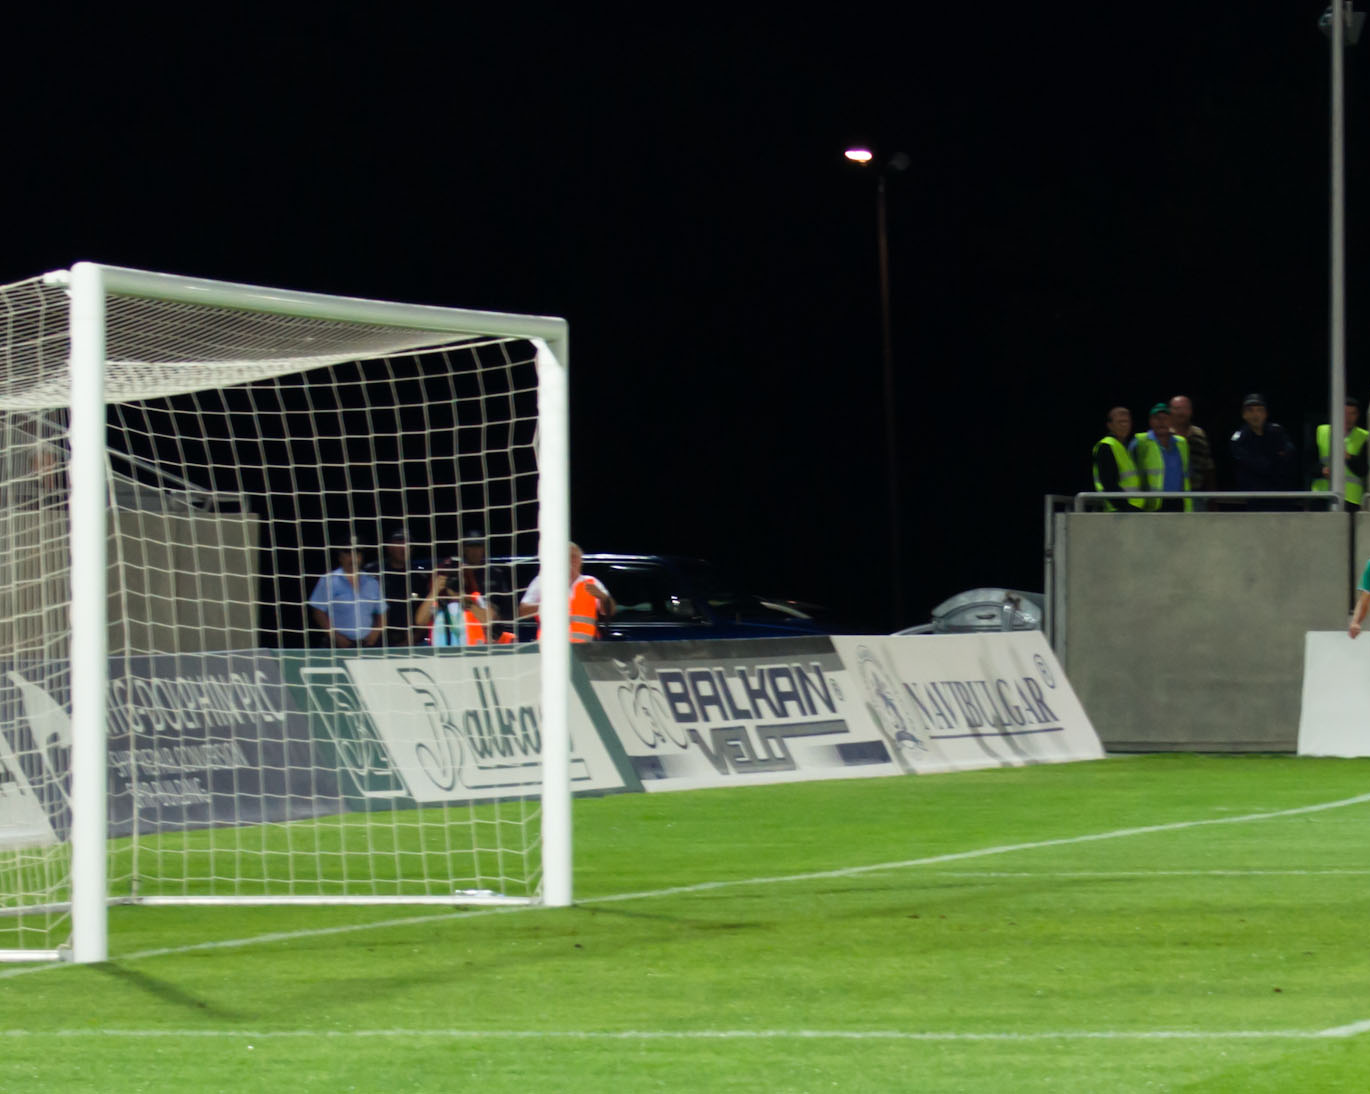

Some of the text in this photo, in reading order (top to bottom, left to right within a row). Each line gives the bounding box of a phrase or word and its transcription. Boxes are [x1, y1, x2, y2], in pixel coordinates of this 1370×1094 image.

[655, 662, 837, 724] BALKAN
[396, 667, 573, 791] Balka
[686, 722, 803, 775] VELO
